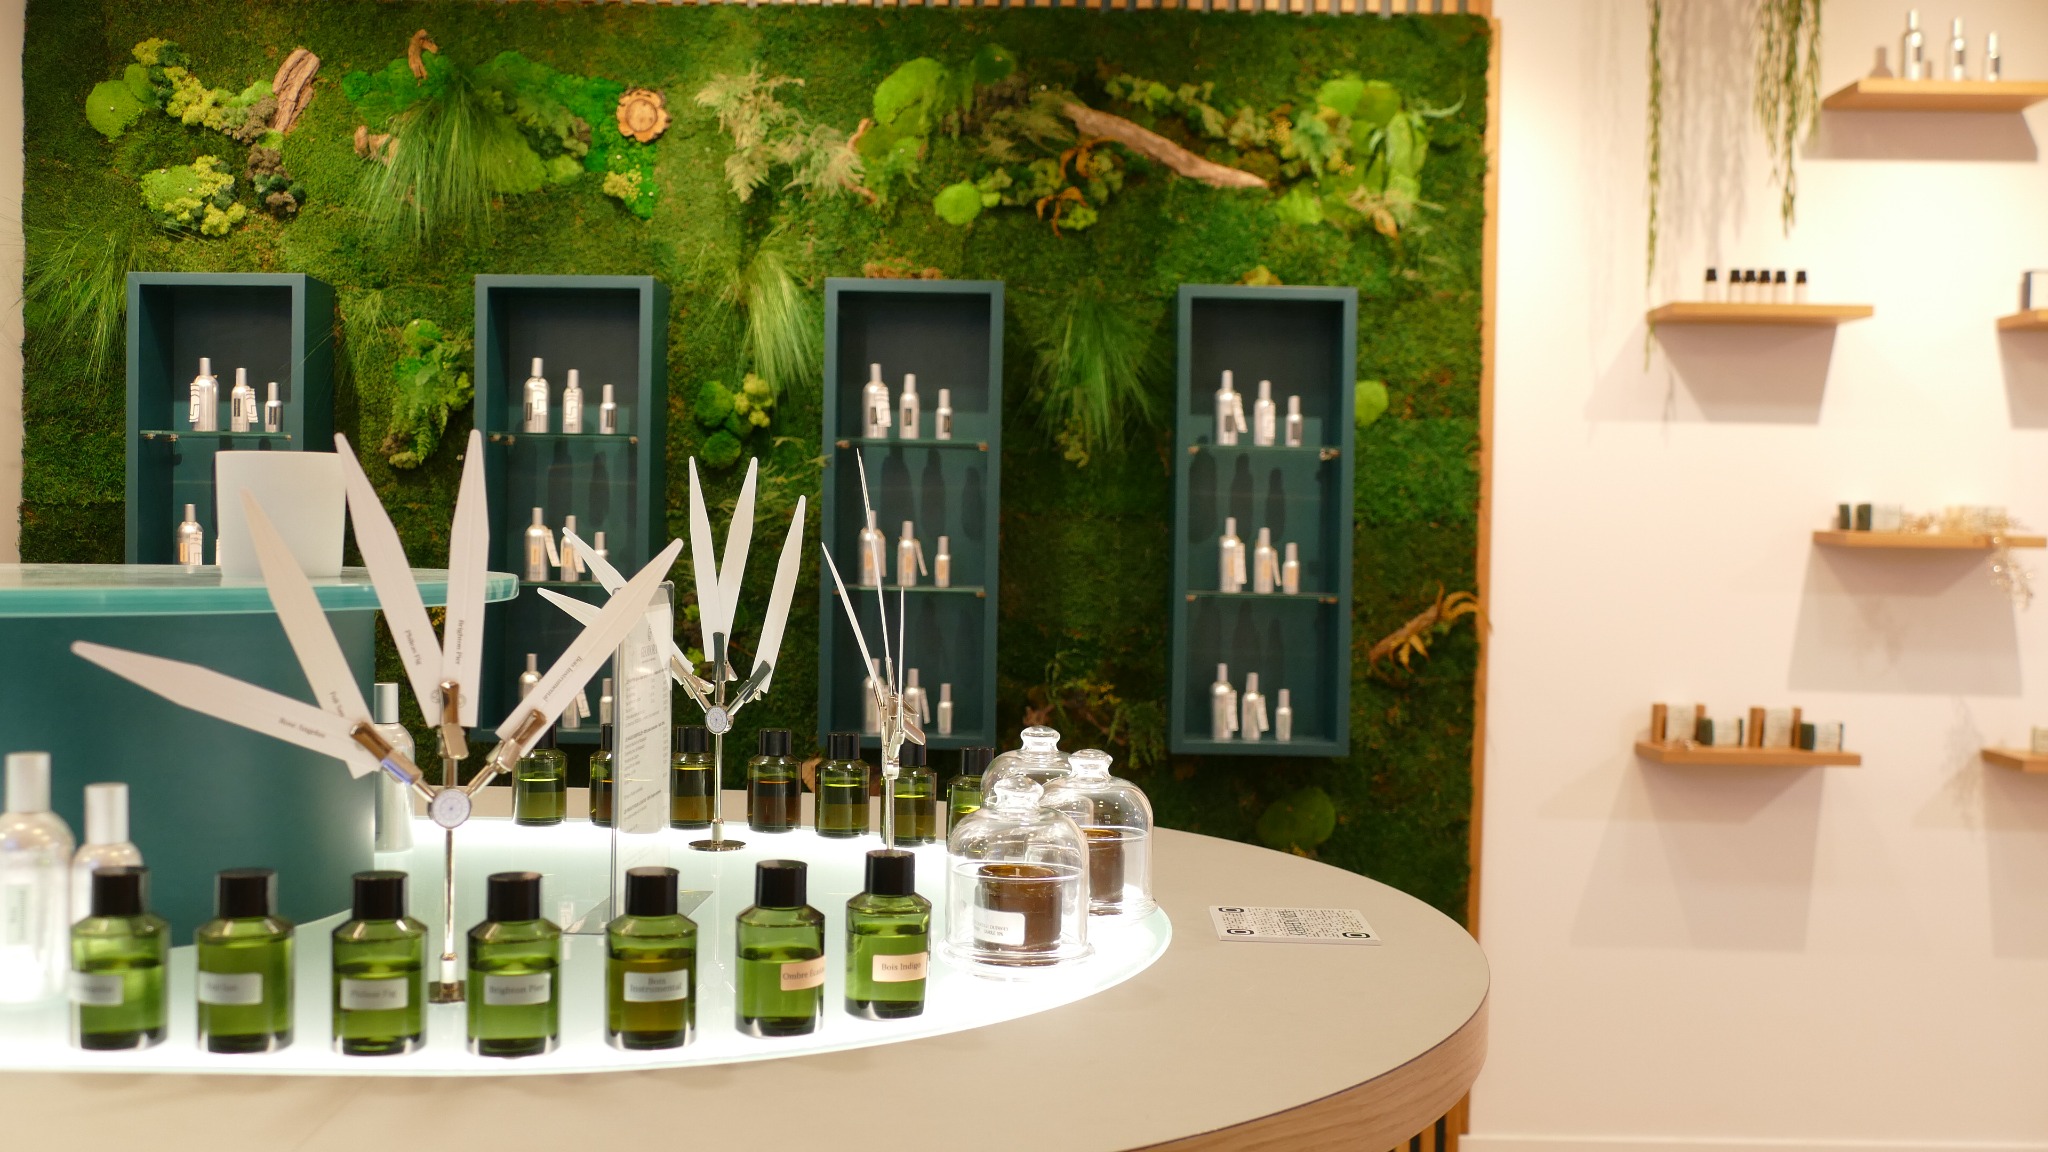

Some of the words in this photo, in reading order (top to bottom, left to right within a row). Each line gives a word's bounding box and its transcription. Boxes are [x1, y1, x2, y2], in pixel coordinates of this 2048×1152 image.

[456, 619, 465, 651] Brighton
[542, 667, 574, 702] Instrumental
[881, 962, 898, 971] Bois
[900, 962, 922, 971] Indigo
[782, 971, 809, 981] Ombre
[488, 985, 527, 996] Brighton
[528, 984, 545, 993] Pier
[630, 983, 683, 993] Instrumental
